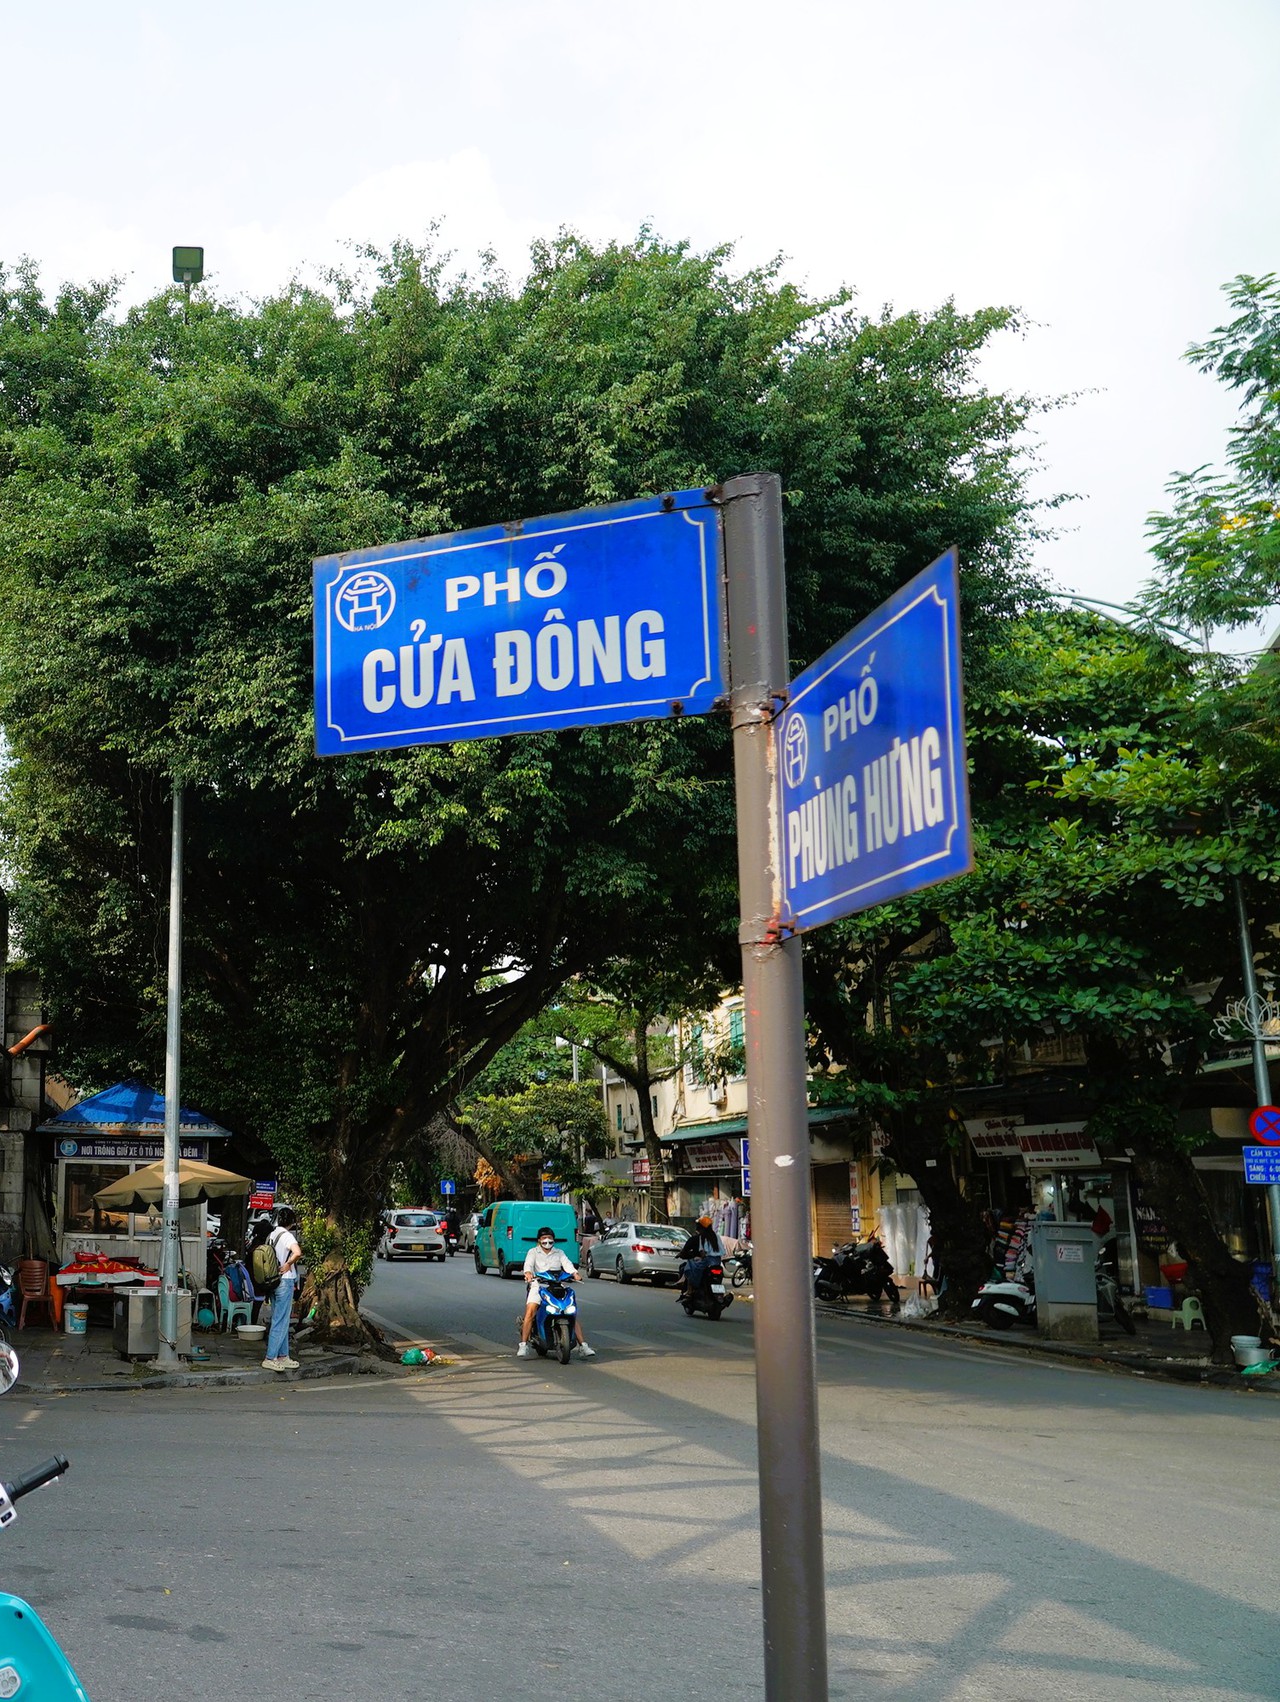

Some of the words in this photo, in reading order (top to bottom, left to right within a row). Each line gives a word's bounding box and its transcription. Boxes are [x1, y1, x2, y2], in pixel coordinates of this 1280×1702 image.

[446, 544, 568, 612] PHỐ
[362, 620, 477, 715] CỬA
[493, 608, 668, 699] ĐÔNG
[823, 651, 880, 752] PHỐ
[786, 772, 860, 890] PHÙNG
[863, 727, 945, 853] HƯNG
[129, 1147, 138, 1156] XE
